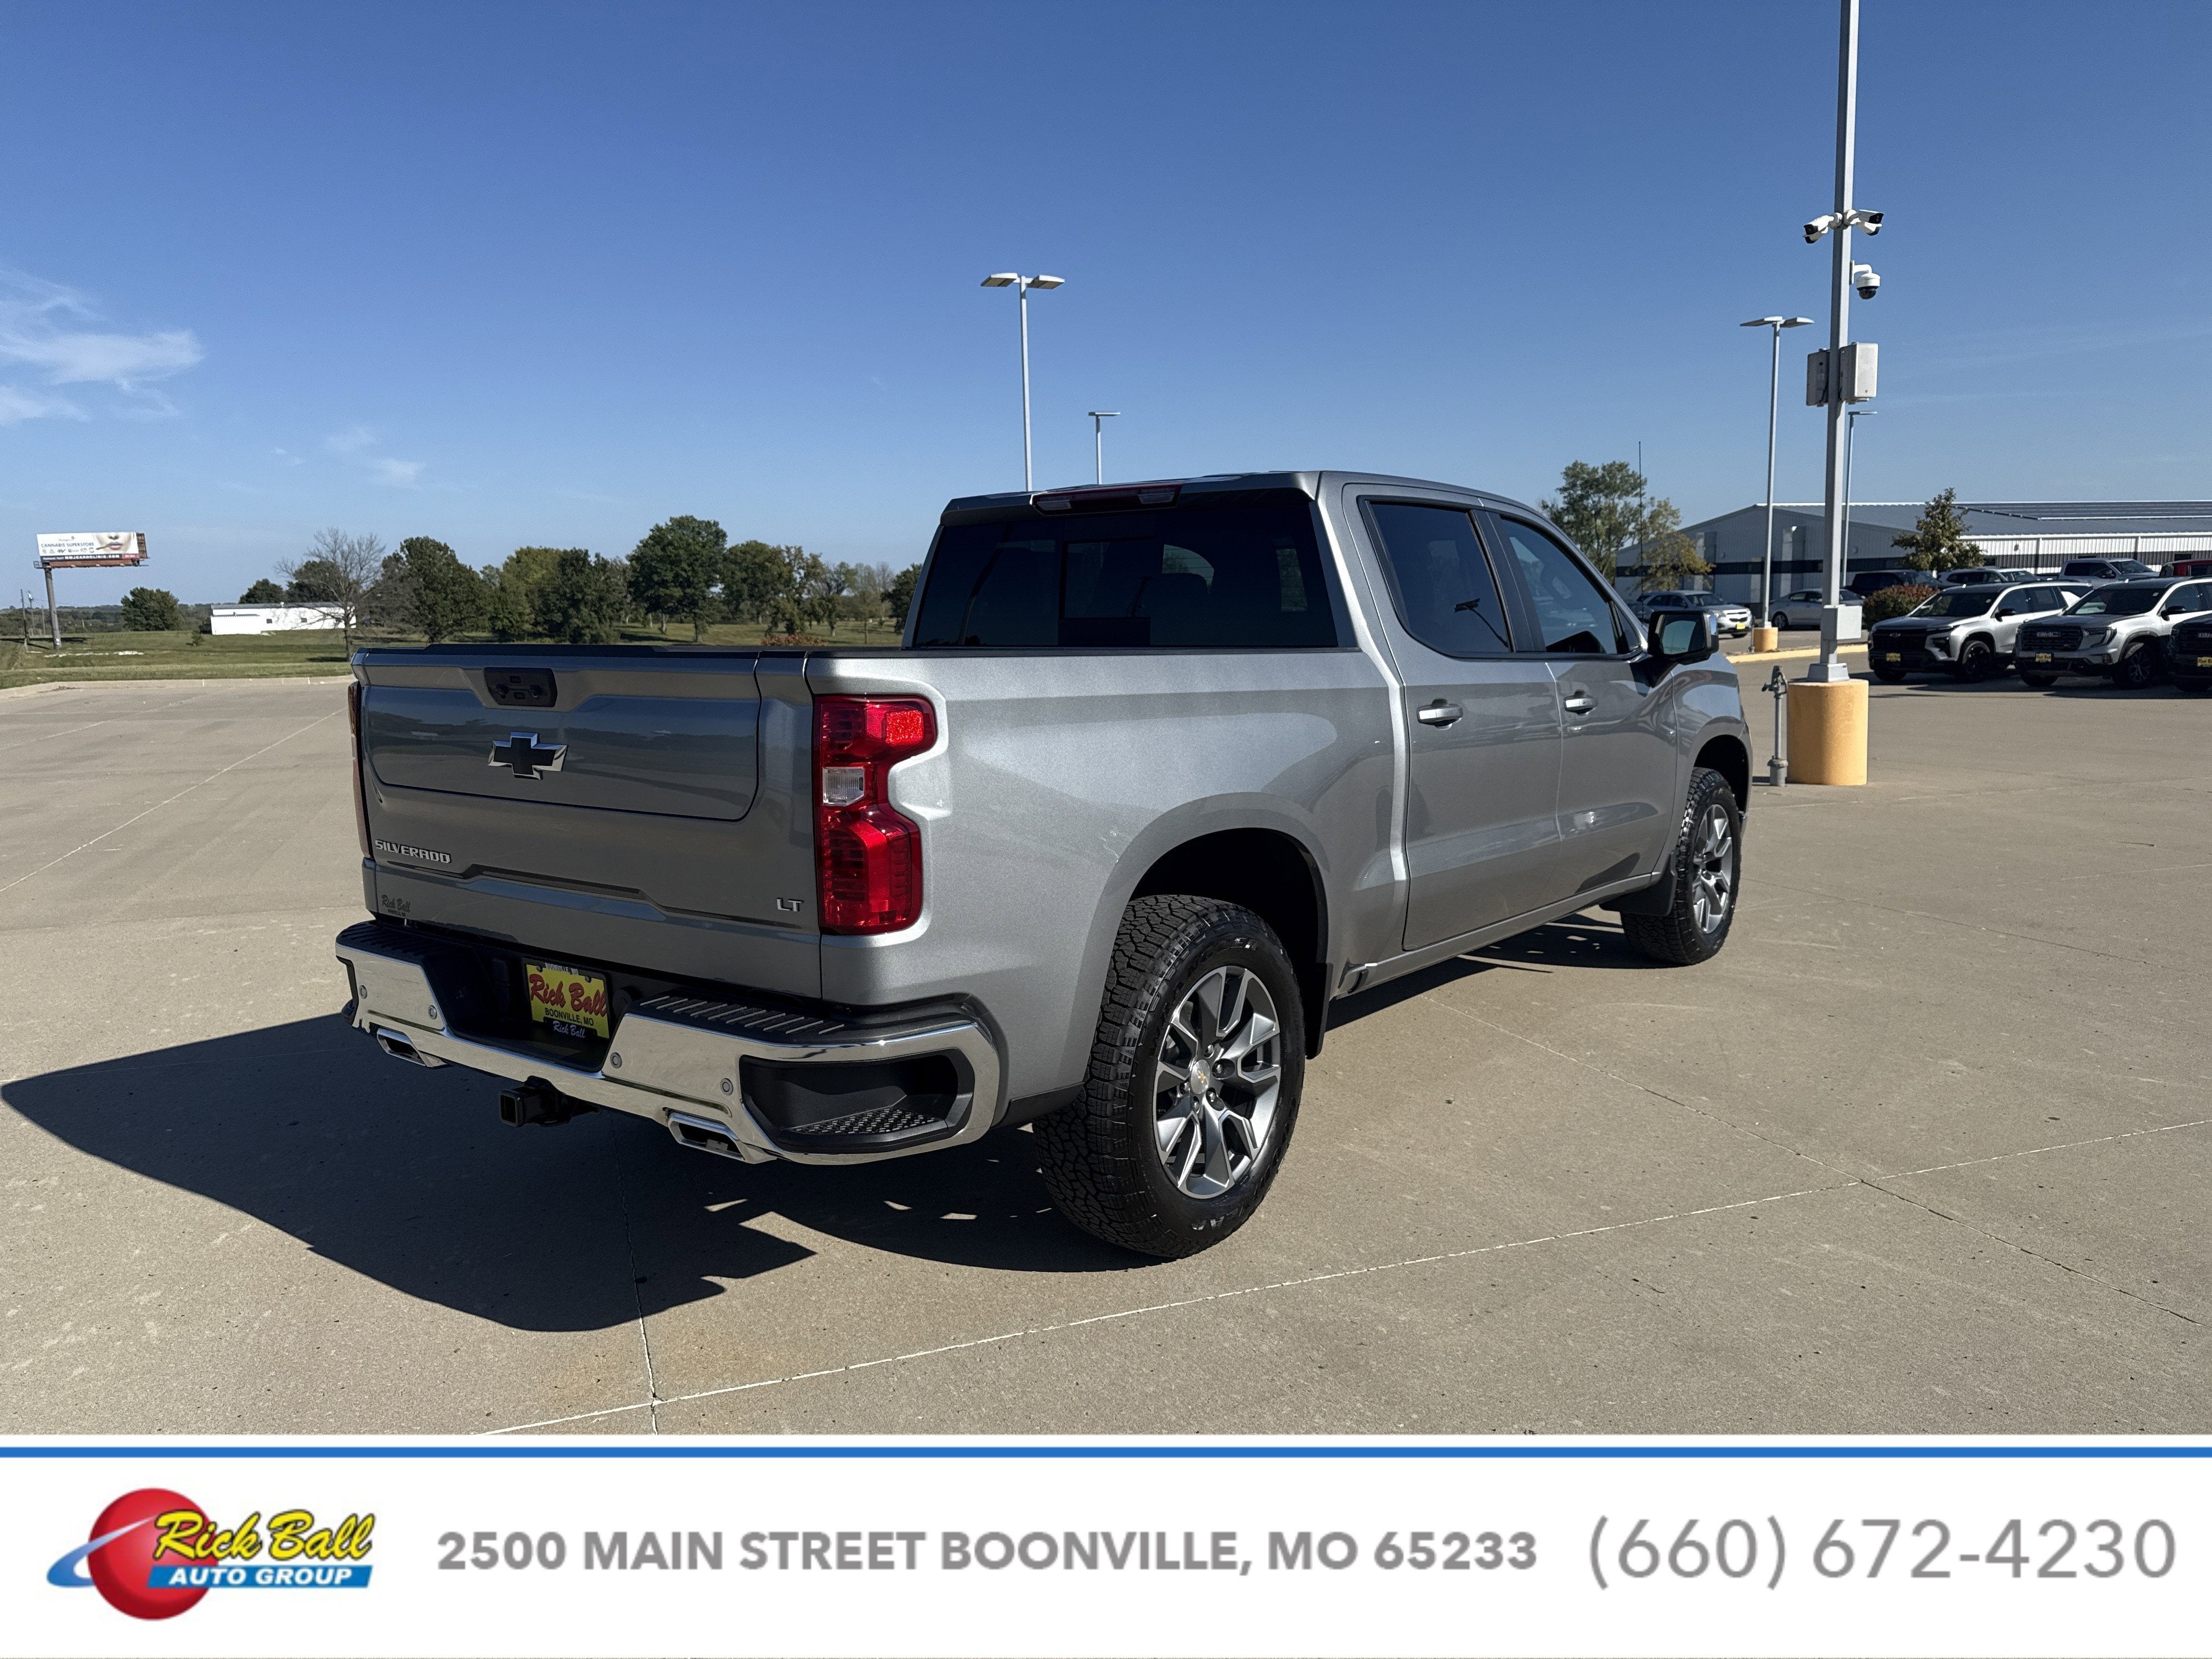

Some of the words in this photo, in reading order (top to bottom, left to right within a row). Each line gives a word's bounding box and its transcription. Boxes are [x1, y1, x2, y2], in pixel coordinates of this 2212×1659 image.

[375, 839, 452, 864] SILVERADO
[777, 898, 803, 912] LT
[529, 974, 566, 1008] Rick
[568, 982, 607, 1018] Ball
[545, 1007, 583, 1025] BOONVILLE,
[583, 1016, 594, 1026] MO
[552, 1020, 569, 1035] Rick
[569, 1024, 585, 1039] Ball
